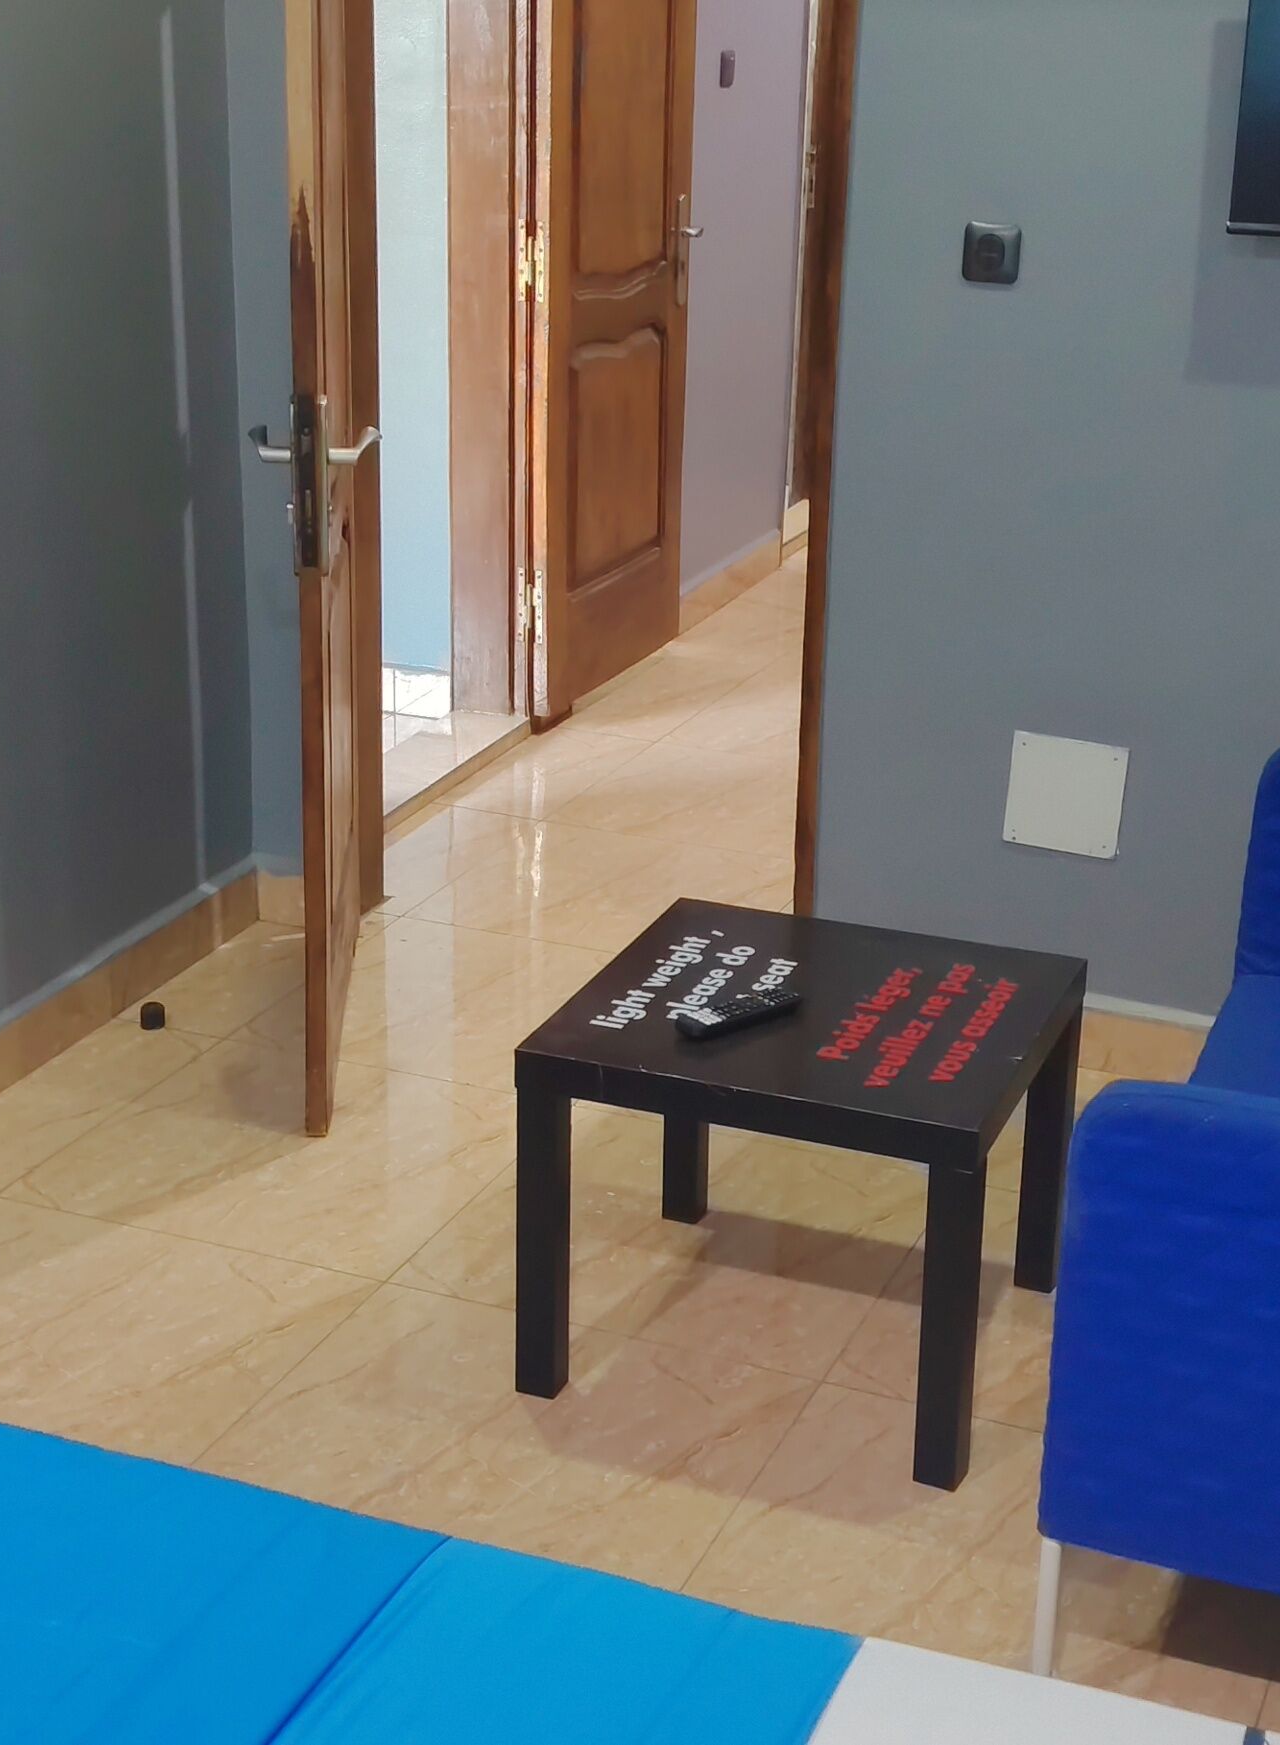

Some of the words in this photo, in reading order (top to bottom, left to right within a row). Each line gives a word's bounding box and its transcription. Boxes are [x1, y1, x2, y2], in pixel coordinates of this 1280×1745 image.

[589, 989, 656, 1029] light
[642, 936, 711, 988] weight
[715, 945, 756, 966] do
[751, 957, 799, 992] seat
[816, 1012, 880, 1060] Poids
[864, 1019, 934, 1087] veuillez
[918, 995, 952, 1018] ne
[937, 963, 976, 994] pas
[928, 1040, 977, 1082] vous
[961, 978, 1019, 1039] asseoir
